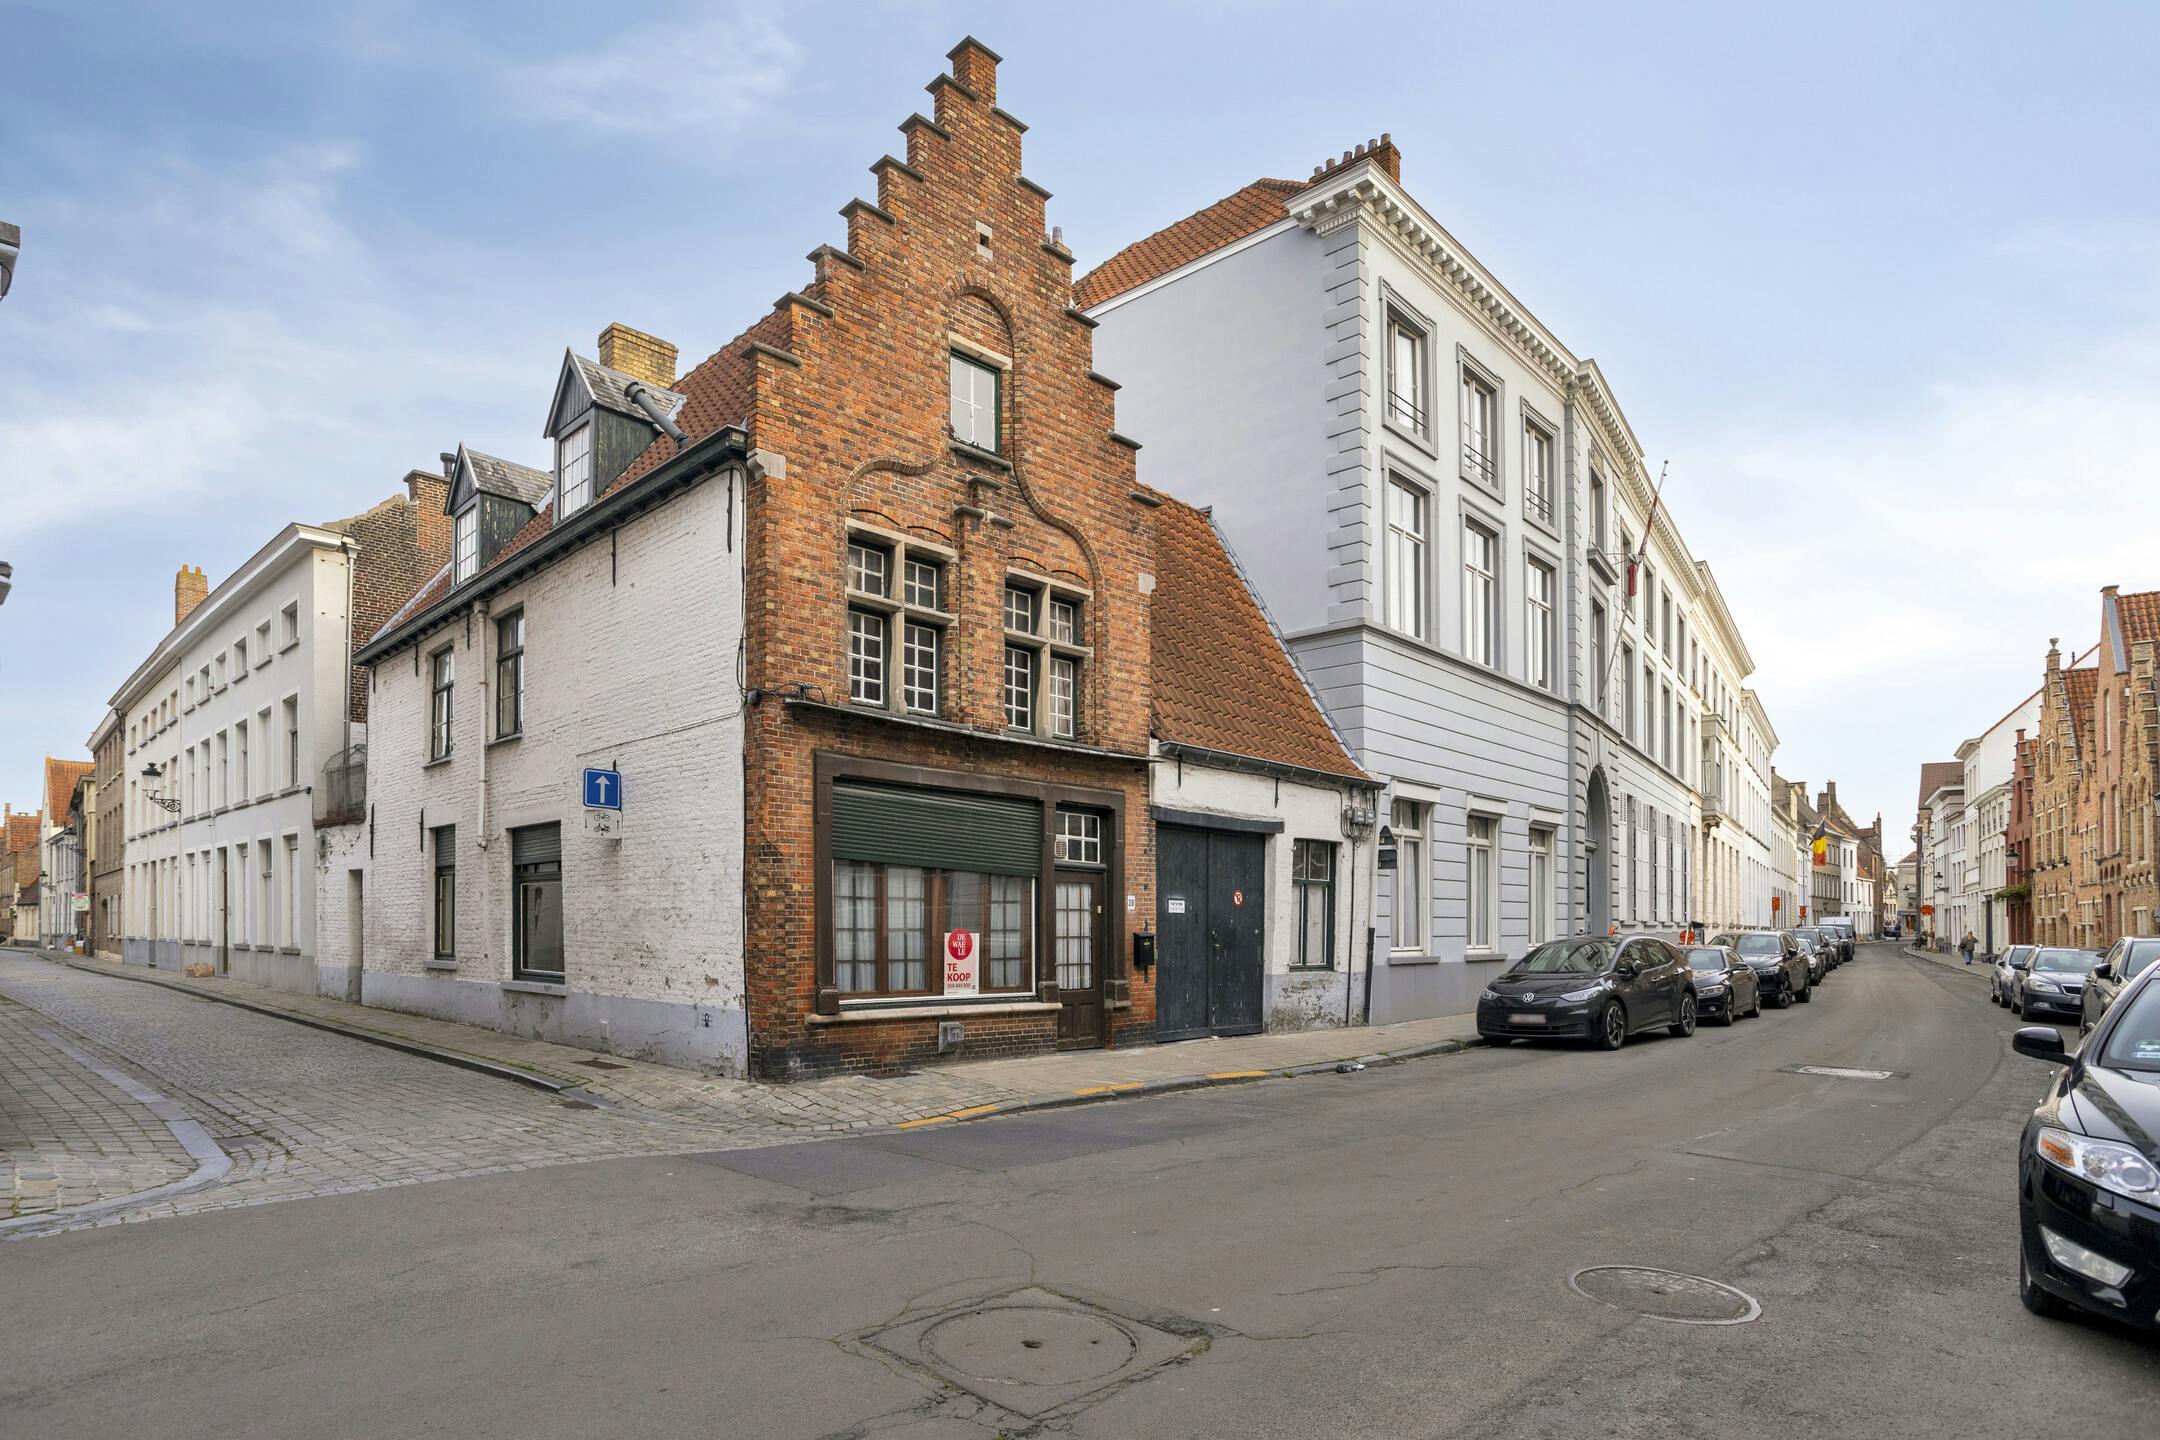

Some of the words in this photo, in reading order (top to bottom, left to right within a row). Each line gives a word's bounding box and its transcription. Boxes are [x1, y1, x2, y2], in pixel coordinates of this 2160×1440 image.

[952, 940, 966, 948] WAE
[947, 963, 958, 972] TE
[947, 972, 971, 982] KOOP
